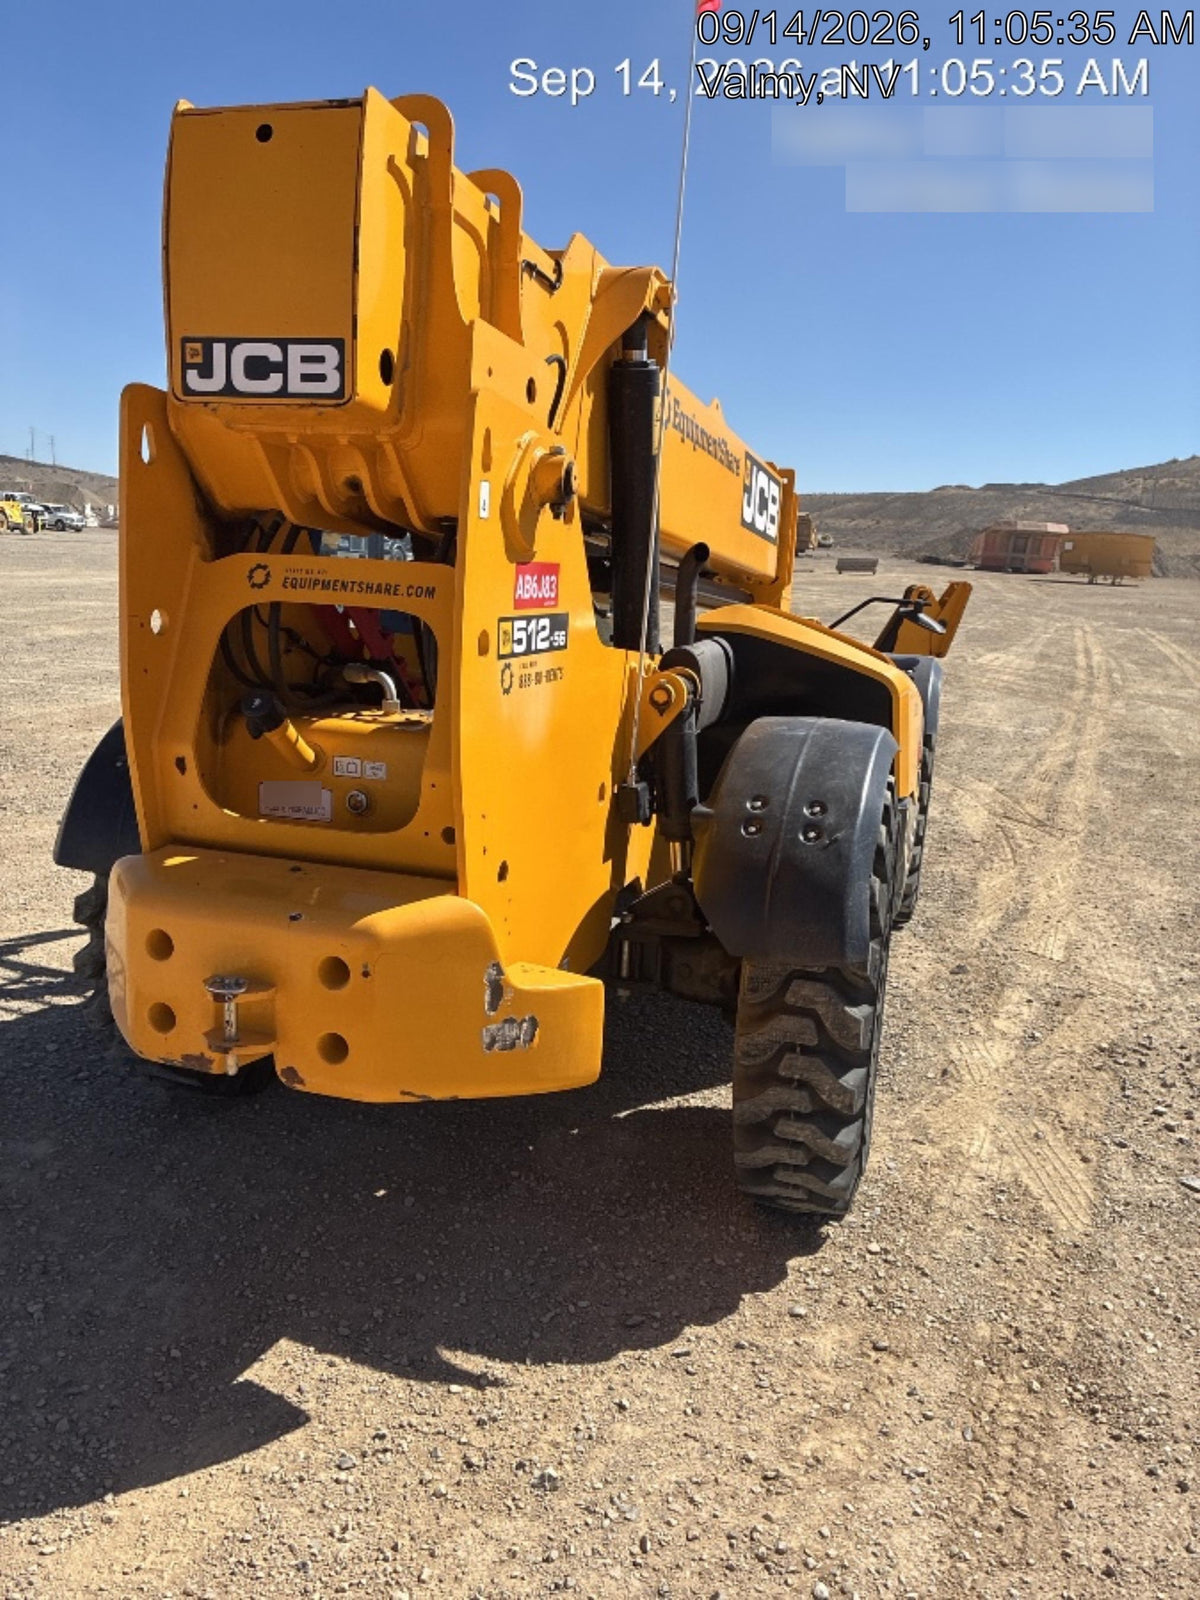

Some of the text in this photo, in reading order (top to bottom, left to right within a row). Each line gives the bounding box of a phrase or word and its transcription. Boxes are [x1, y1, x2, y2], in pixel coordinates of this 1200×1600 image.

[186, 342, 341, 394] JCB
[742, 464, 781, 539] JCB
[282, 576, 436, 600] EQUIPMENTSHARE.COM
[515, 573, 558, 600] AB6J83
[513, 617, 567, 654] 512-56
